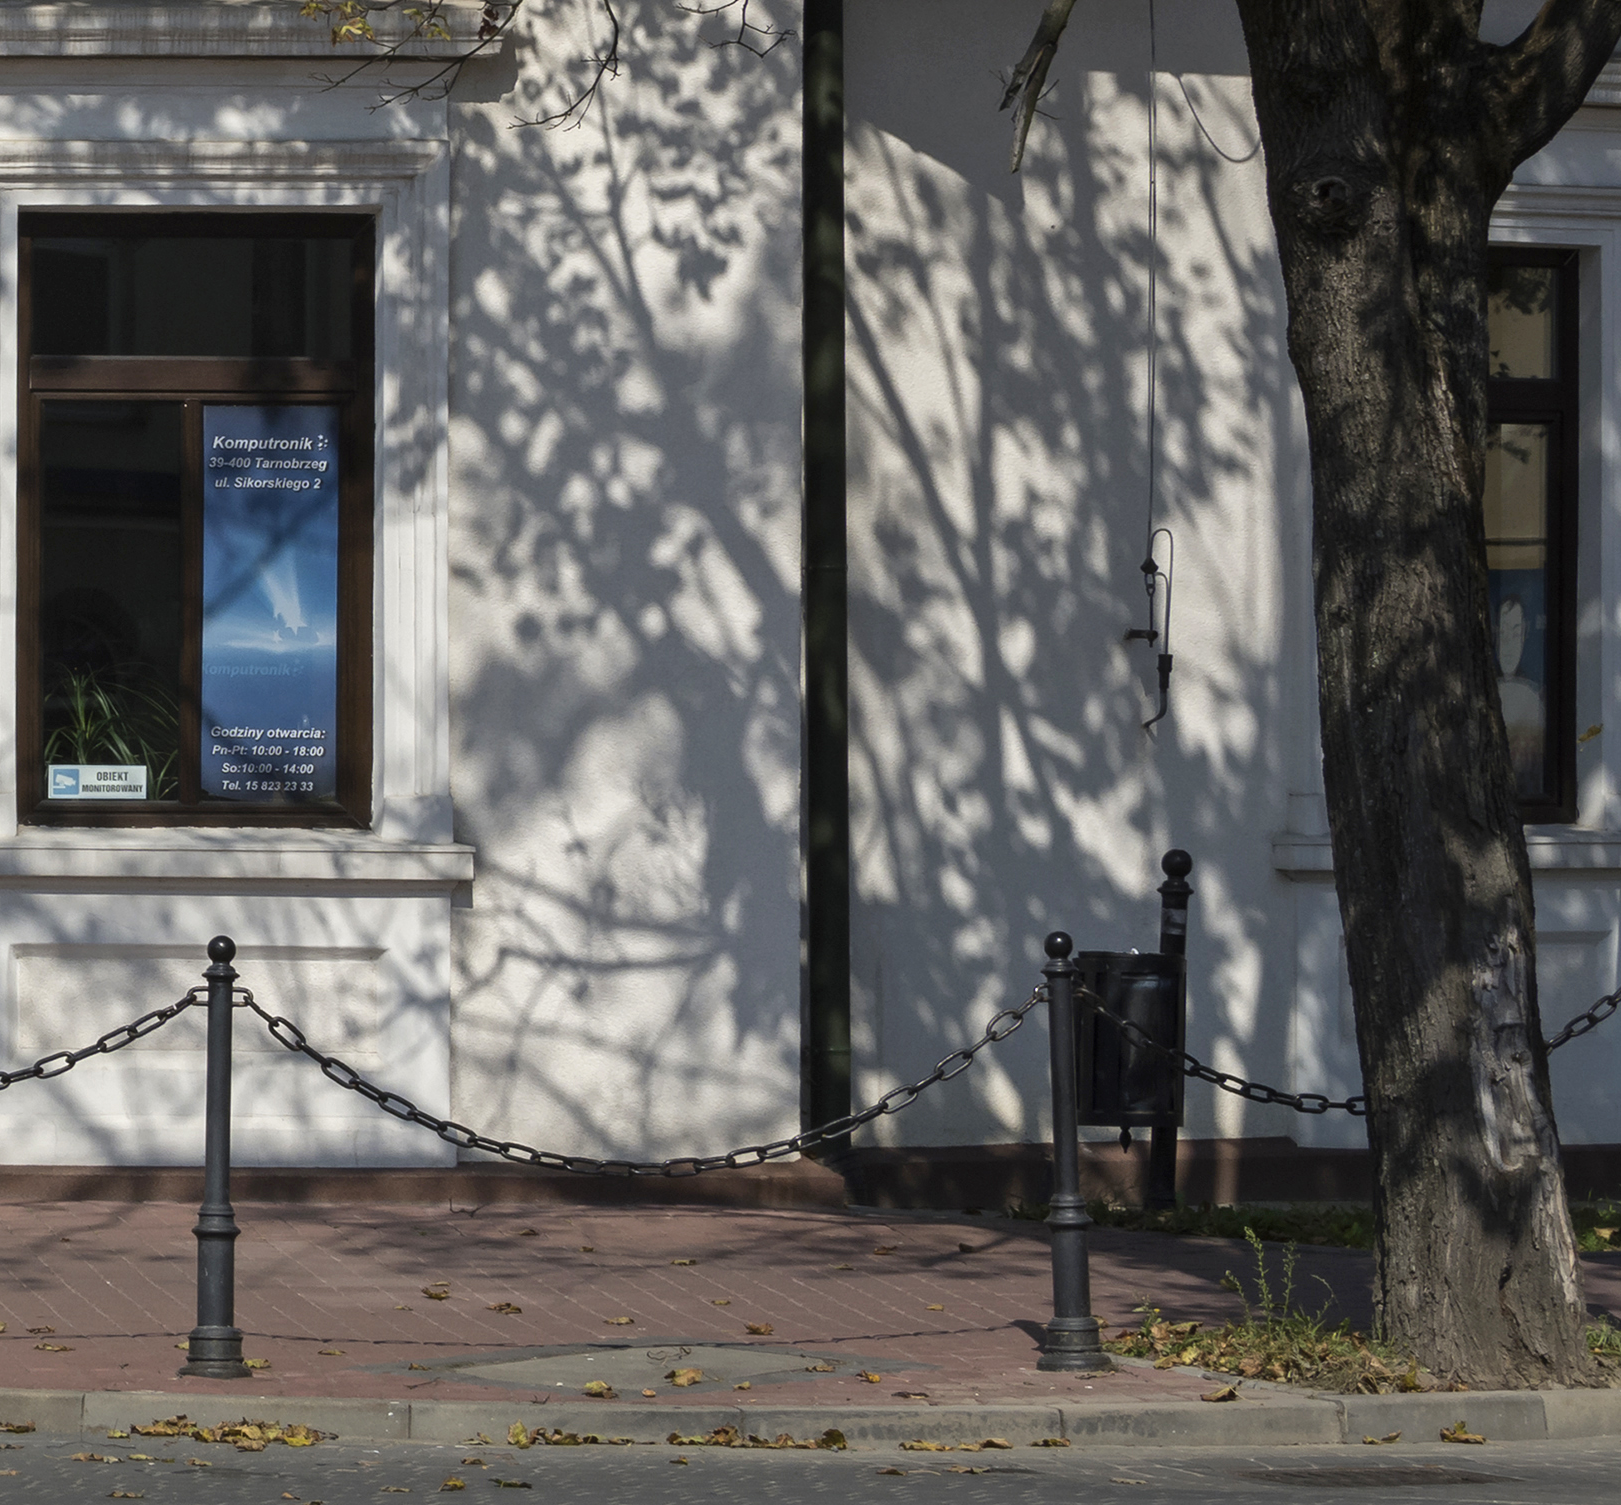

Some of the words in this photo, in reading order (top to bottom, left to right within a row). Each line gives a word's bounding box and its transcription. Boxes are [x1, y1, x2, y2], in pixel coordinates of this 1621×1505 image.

[212, 436, 313, 452] Komputronik
[209, 457, 251, 468] 39-400
[255, 457, 327, 472] Tarnobrzeg
[215, 477, 230, 488] ul.
[234, 477, 310, 491] Sikorskiego
[313, 478, 321, 489] 2
[211, 726, 263, 740] Godziny
[266, 727, 326, 739] otwarcia:
[212, 745, 248, 755] Pn-Pt:
[251, 745, 282, 756] 10:00
[293, 746, 324, 757] 18:00
[282, 763, 314, 774] 14:00
[96, 771, 129, 781] OBIEKT
[81, 784, 144, 793] MONITOROWANY
[222, 780, 241, 790] Tel.
[245, 781, 258, 790] 15
[261, 781, 281, 791] 823
[284, 781, 297, 791] 23
[300, 781, 314, 792] 33
